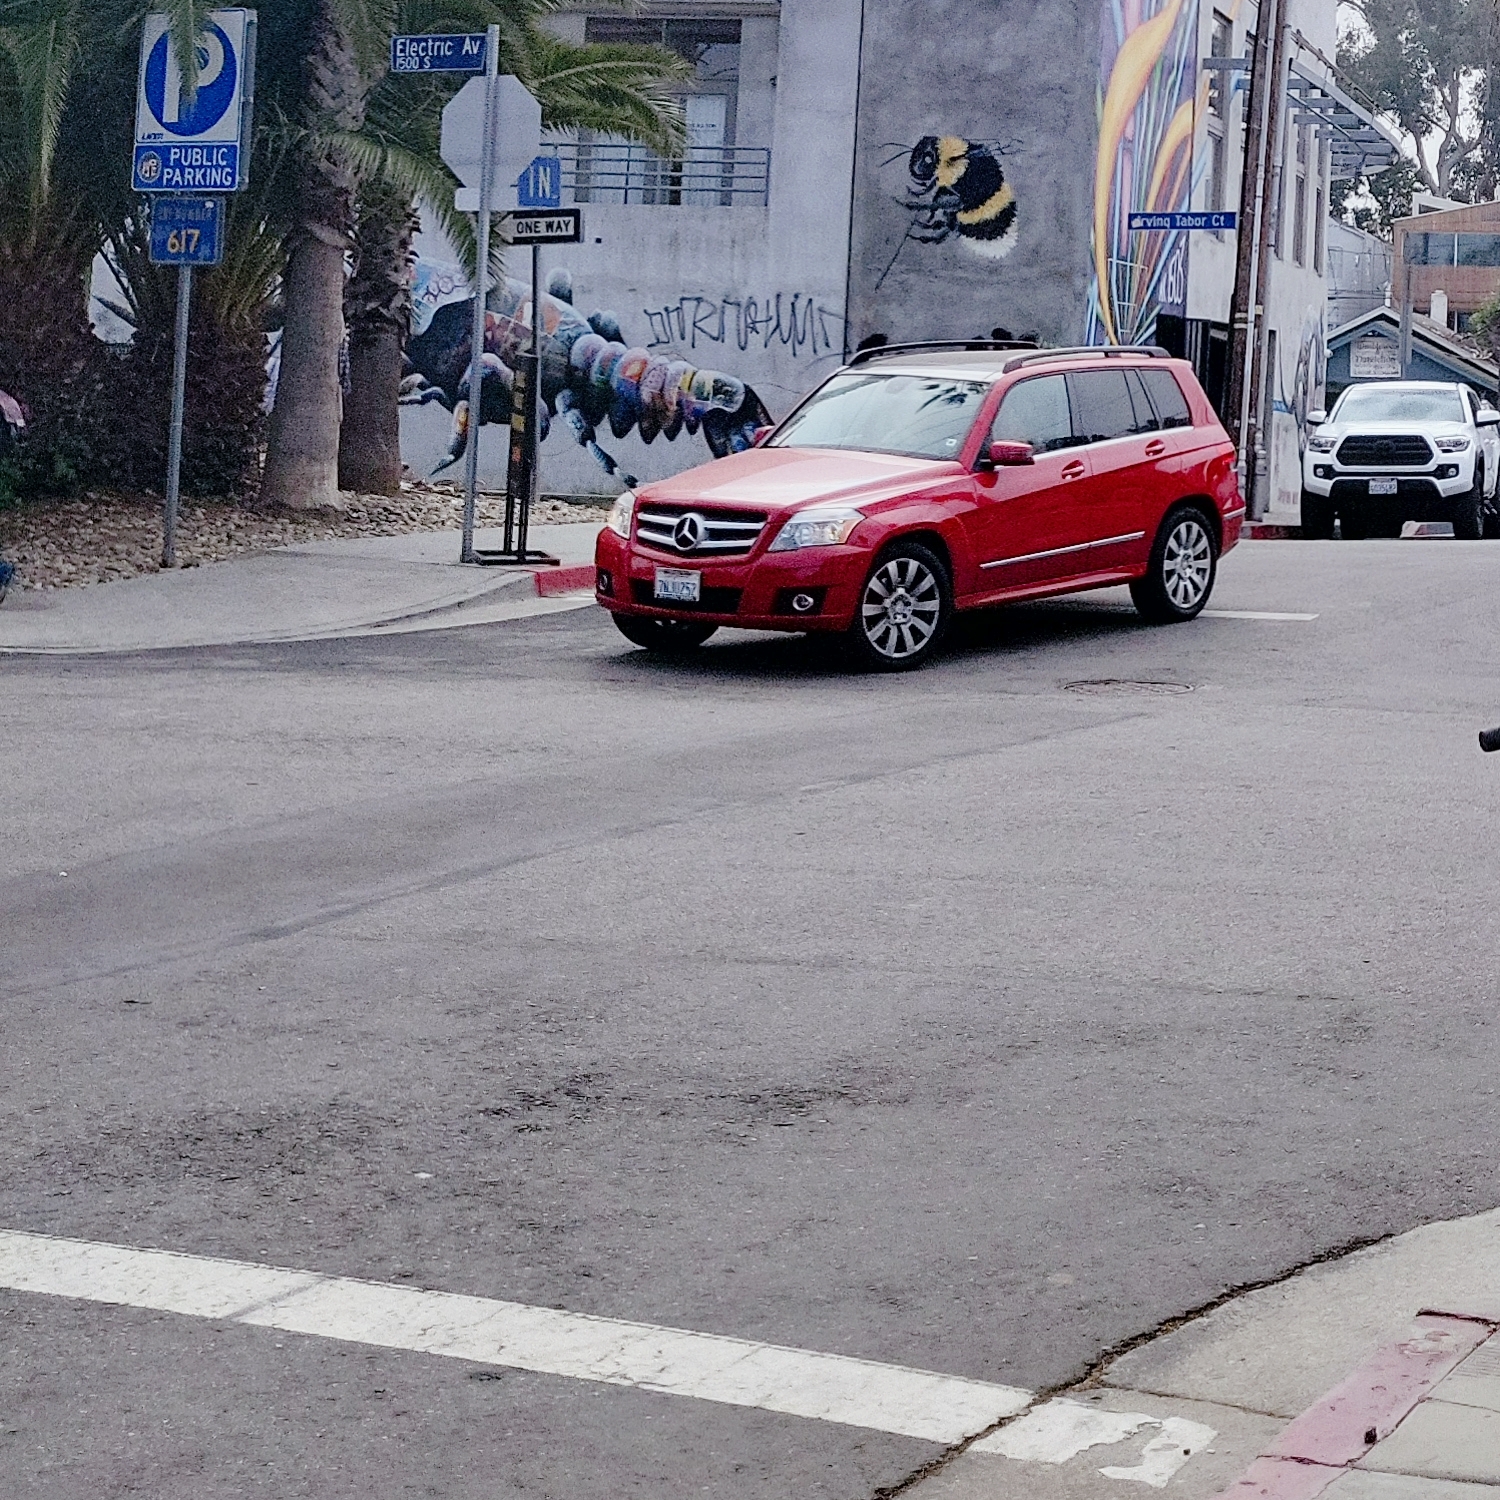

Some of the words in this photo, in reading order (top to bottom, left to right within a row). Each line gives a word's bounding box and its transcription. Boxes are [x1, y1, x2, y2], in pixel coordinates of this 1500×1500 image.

[396, 39, 453, 57] Electric
[462, 36, 480, 55] Av
[396, 56, 419, 69] 1500
[423, 55, 431, 68] S
[169, 148, 228, 167] PUBLIC
[162, 167, 232, 187] PARKING
[516, 219, 541, 234] ONE
[544, 218, 572, 234] WAY
[1133, 215, 1170, 228] rving
[1175, 214, 1206, 227] Tabor
[1211, 214, 1226, 227] Ct
[167, 229, 200, 254] 617
